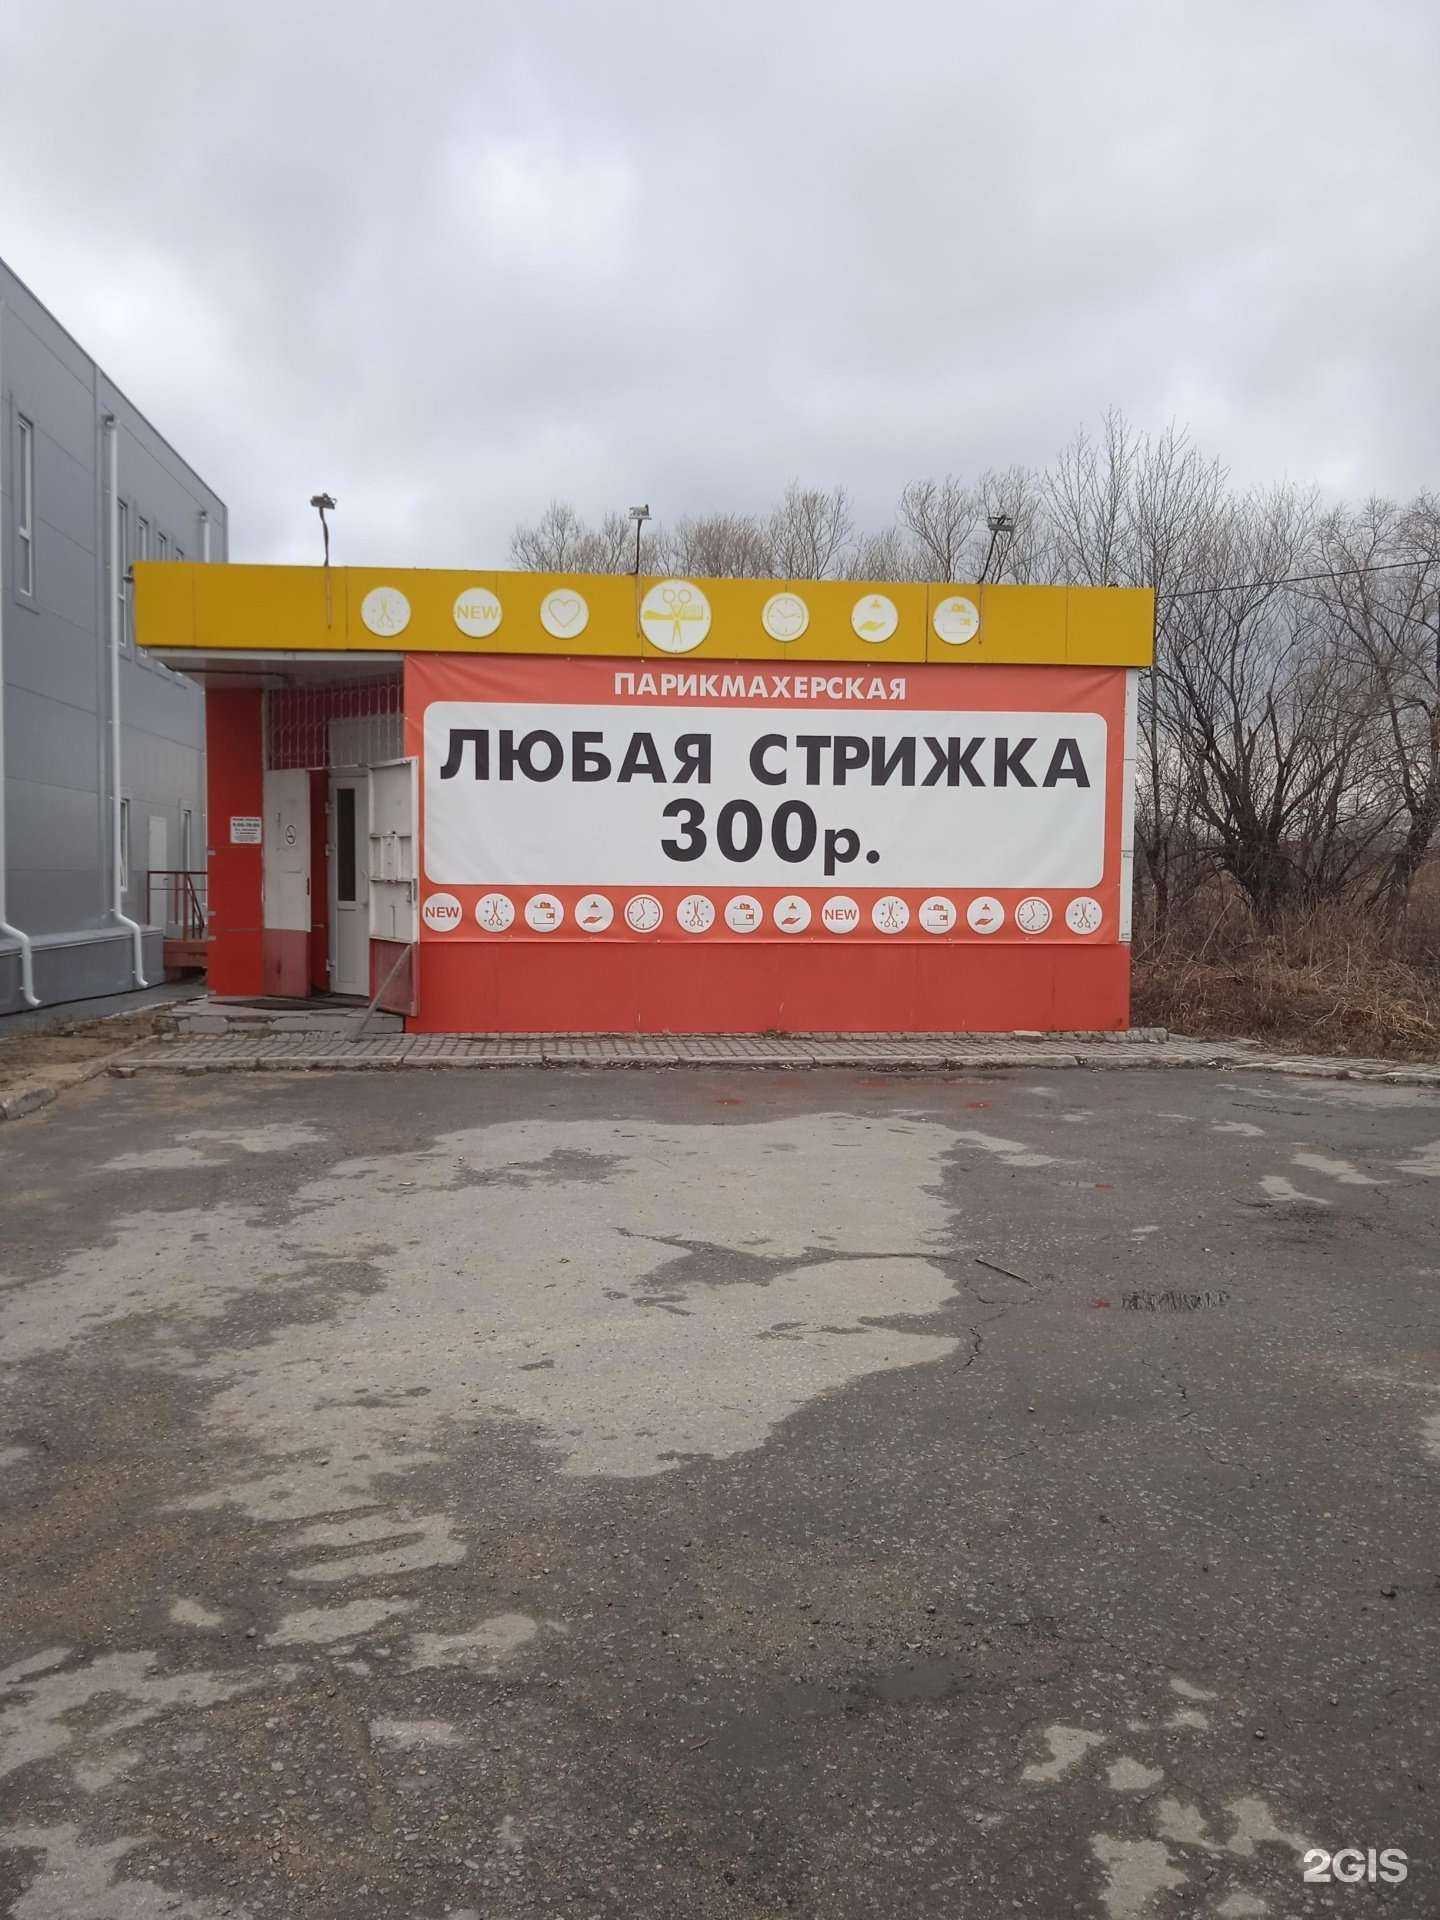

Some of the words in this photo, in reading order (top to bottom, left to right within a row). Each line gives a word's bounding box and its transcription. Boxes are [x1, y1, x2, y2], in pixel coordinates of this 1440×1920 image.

[456, 604, 500, 620] NEW
[614, 672, 906, 701] ПАРИКМАХЕРСКАЯ
[440, 728, 712, 784] ЛЮБАЯ
[749, 733, 1091, 788] СТРИЖКА
[661, 798, 880, 876] 300р.
[425, 906, 459, 919] NEW
[825, 909, 857, 921] NEW
